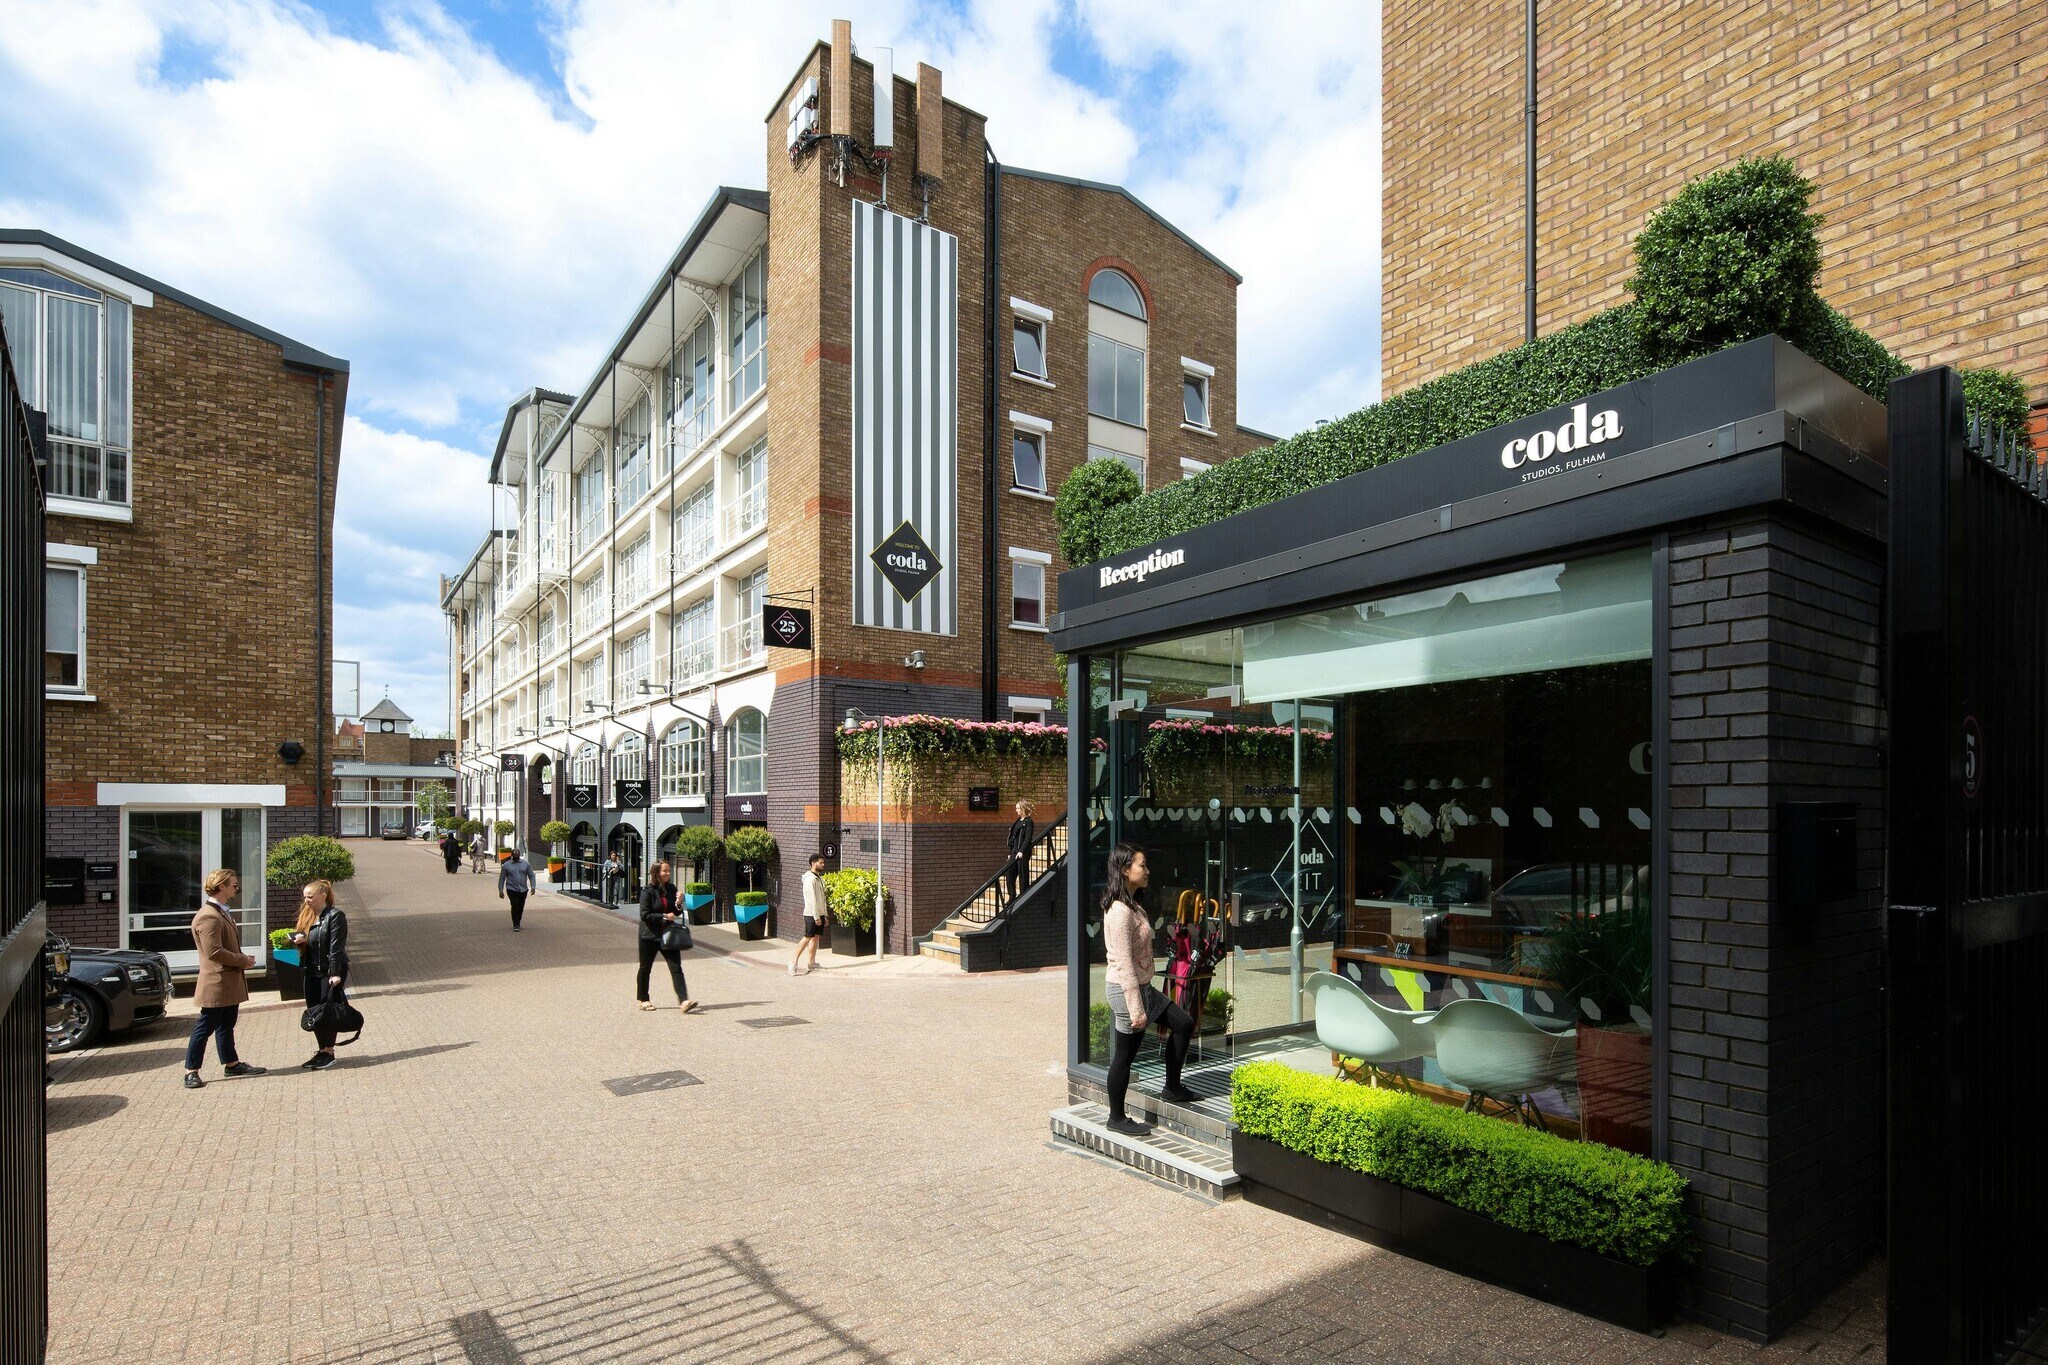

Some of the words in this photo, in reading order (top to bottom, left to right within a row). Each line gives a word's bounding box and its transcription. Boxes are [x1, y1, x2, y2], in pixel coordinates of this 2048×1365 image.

[1501, 402, 1624, 469] coda
[1521, 464, 1563, 482] STUDIOS,
[1566, 452, 1606, 470] FULHAM
[886, 551, 928, 571] coda
[1100, 548, 1185, 588] Reception
[779, 619, 796, 634] 25
[1965, 733, 1976, 779] 5
[1299, 847, 1325, 865] oda
